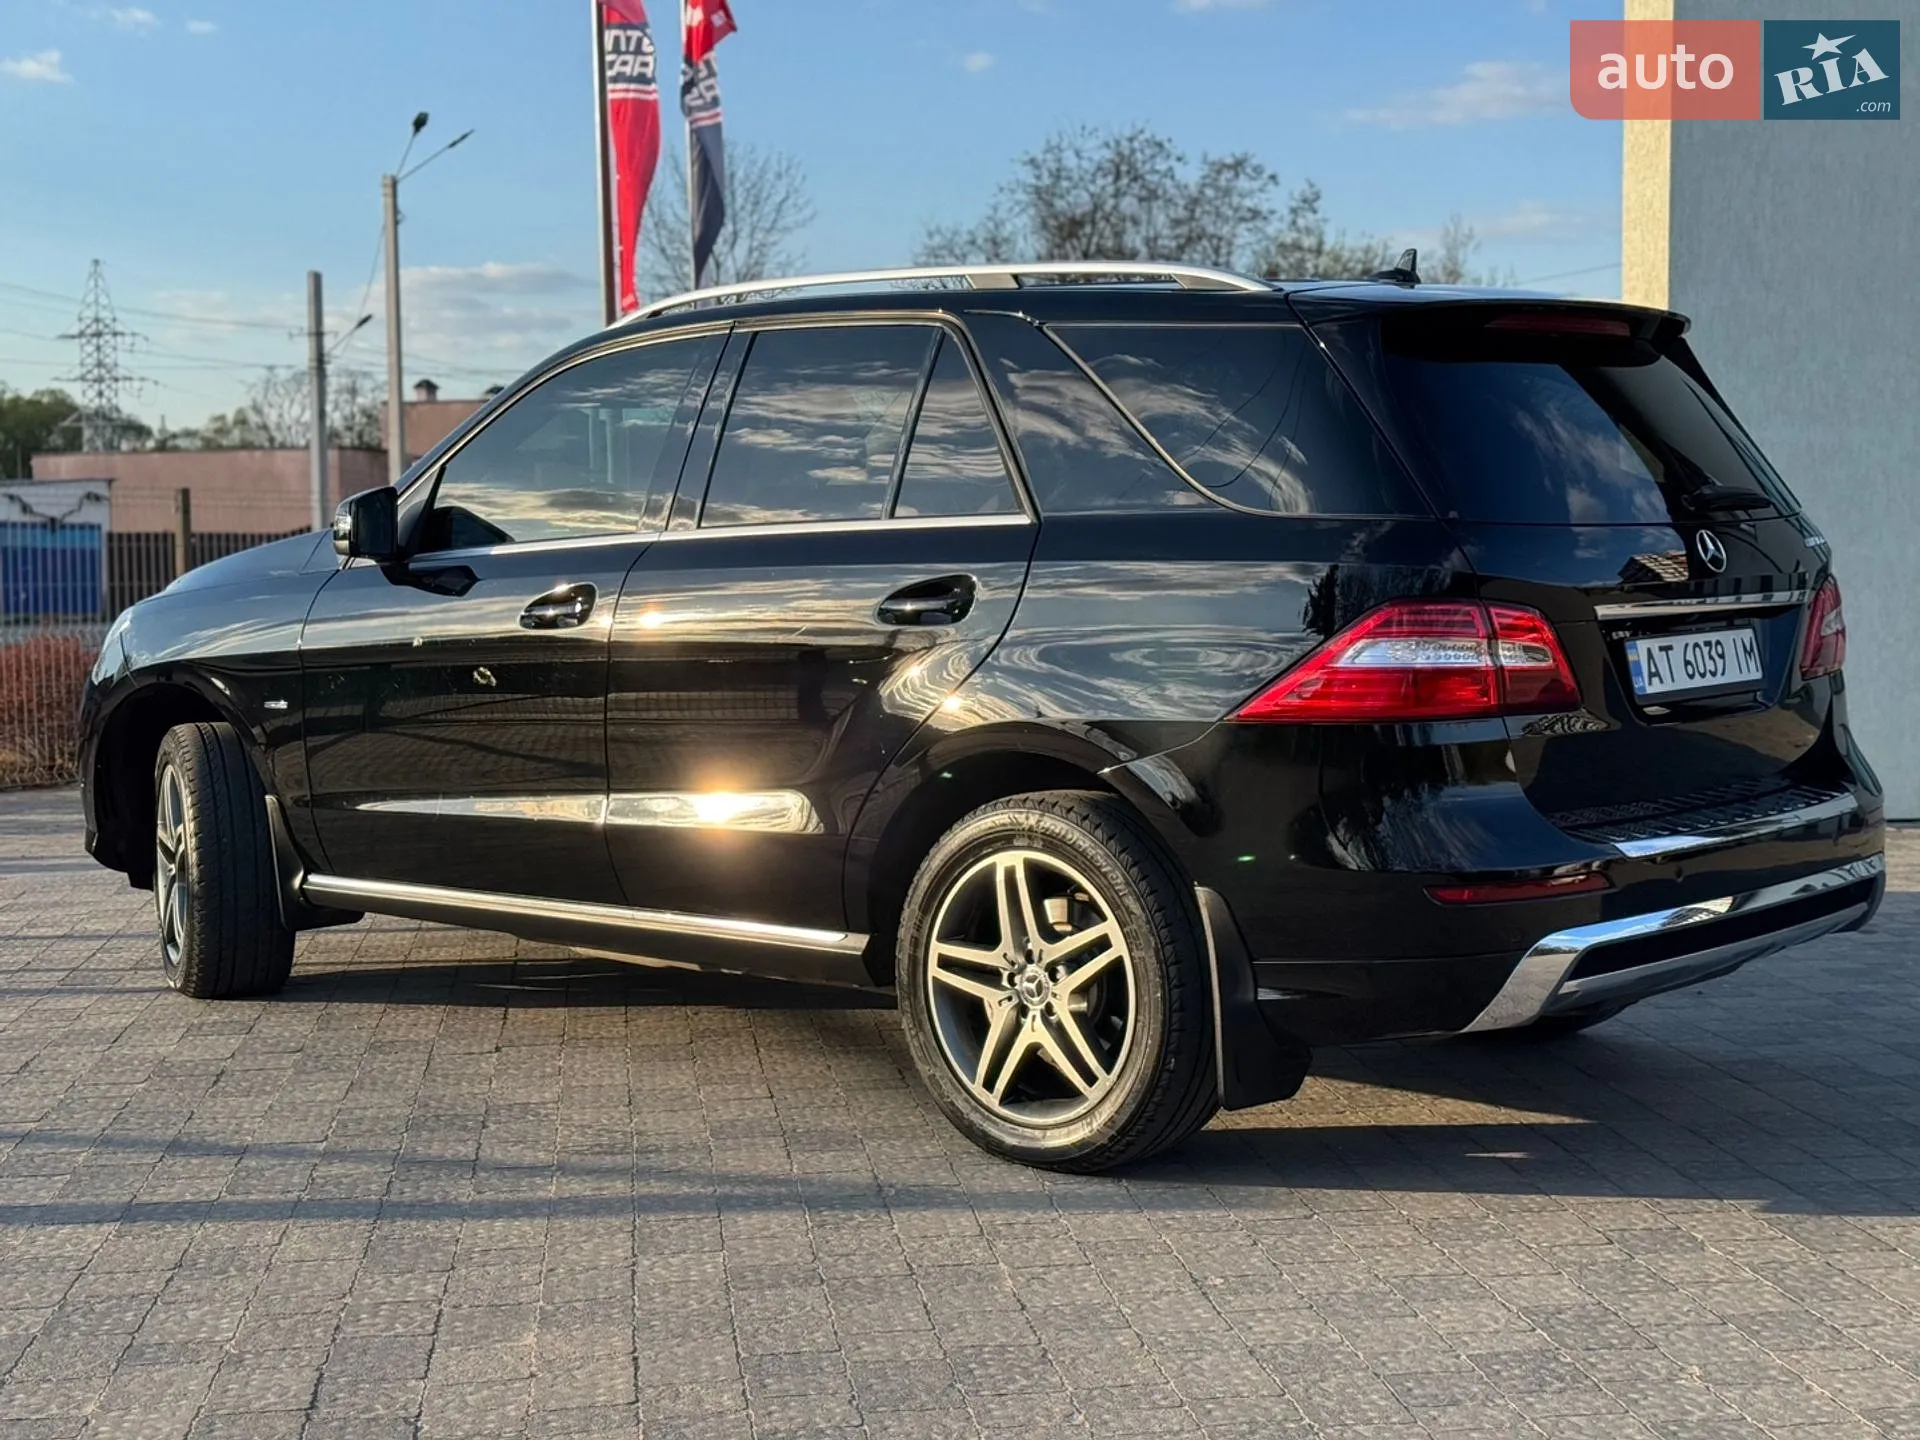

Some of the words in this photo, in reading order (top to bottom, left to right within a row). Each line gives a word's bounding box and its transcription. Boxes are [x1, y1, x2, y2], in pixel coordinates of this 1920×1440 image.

[1646, 644, 1675, 686] AT
[1683, 639, 1726, 680] 6039
[1732, 636, 1759, 675] IM
